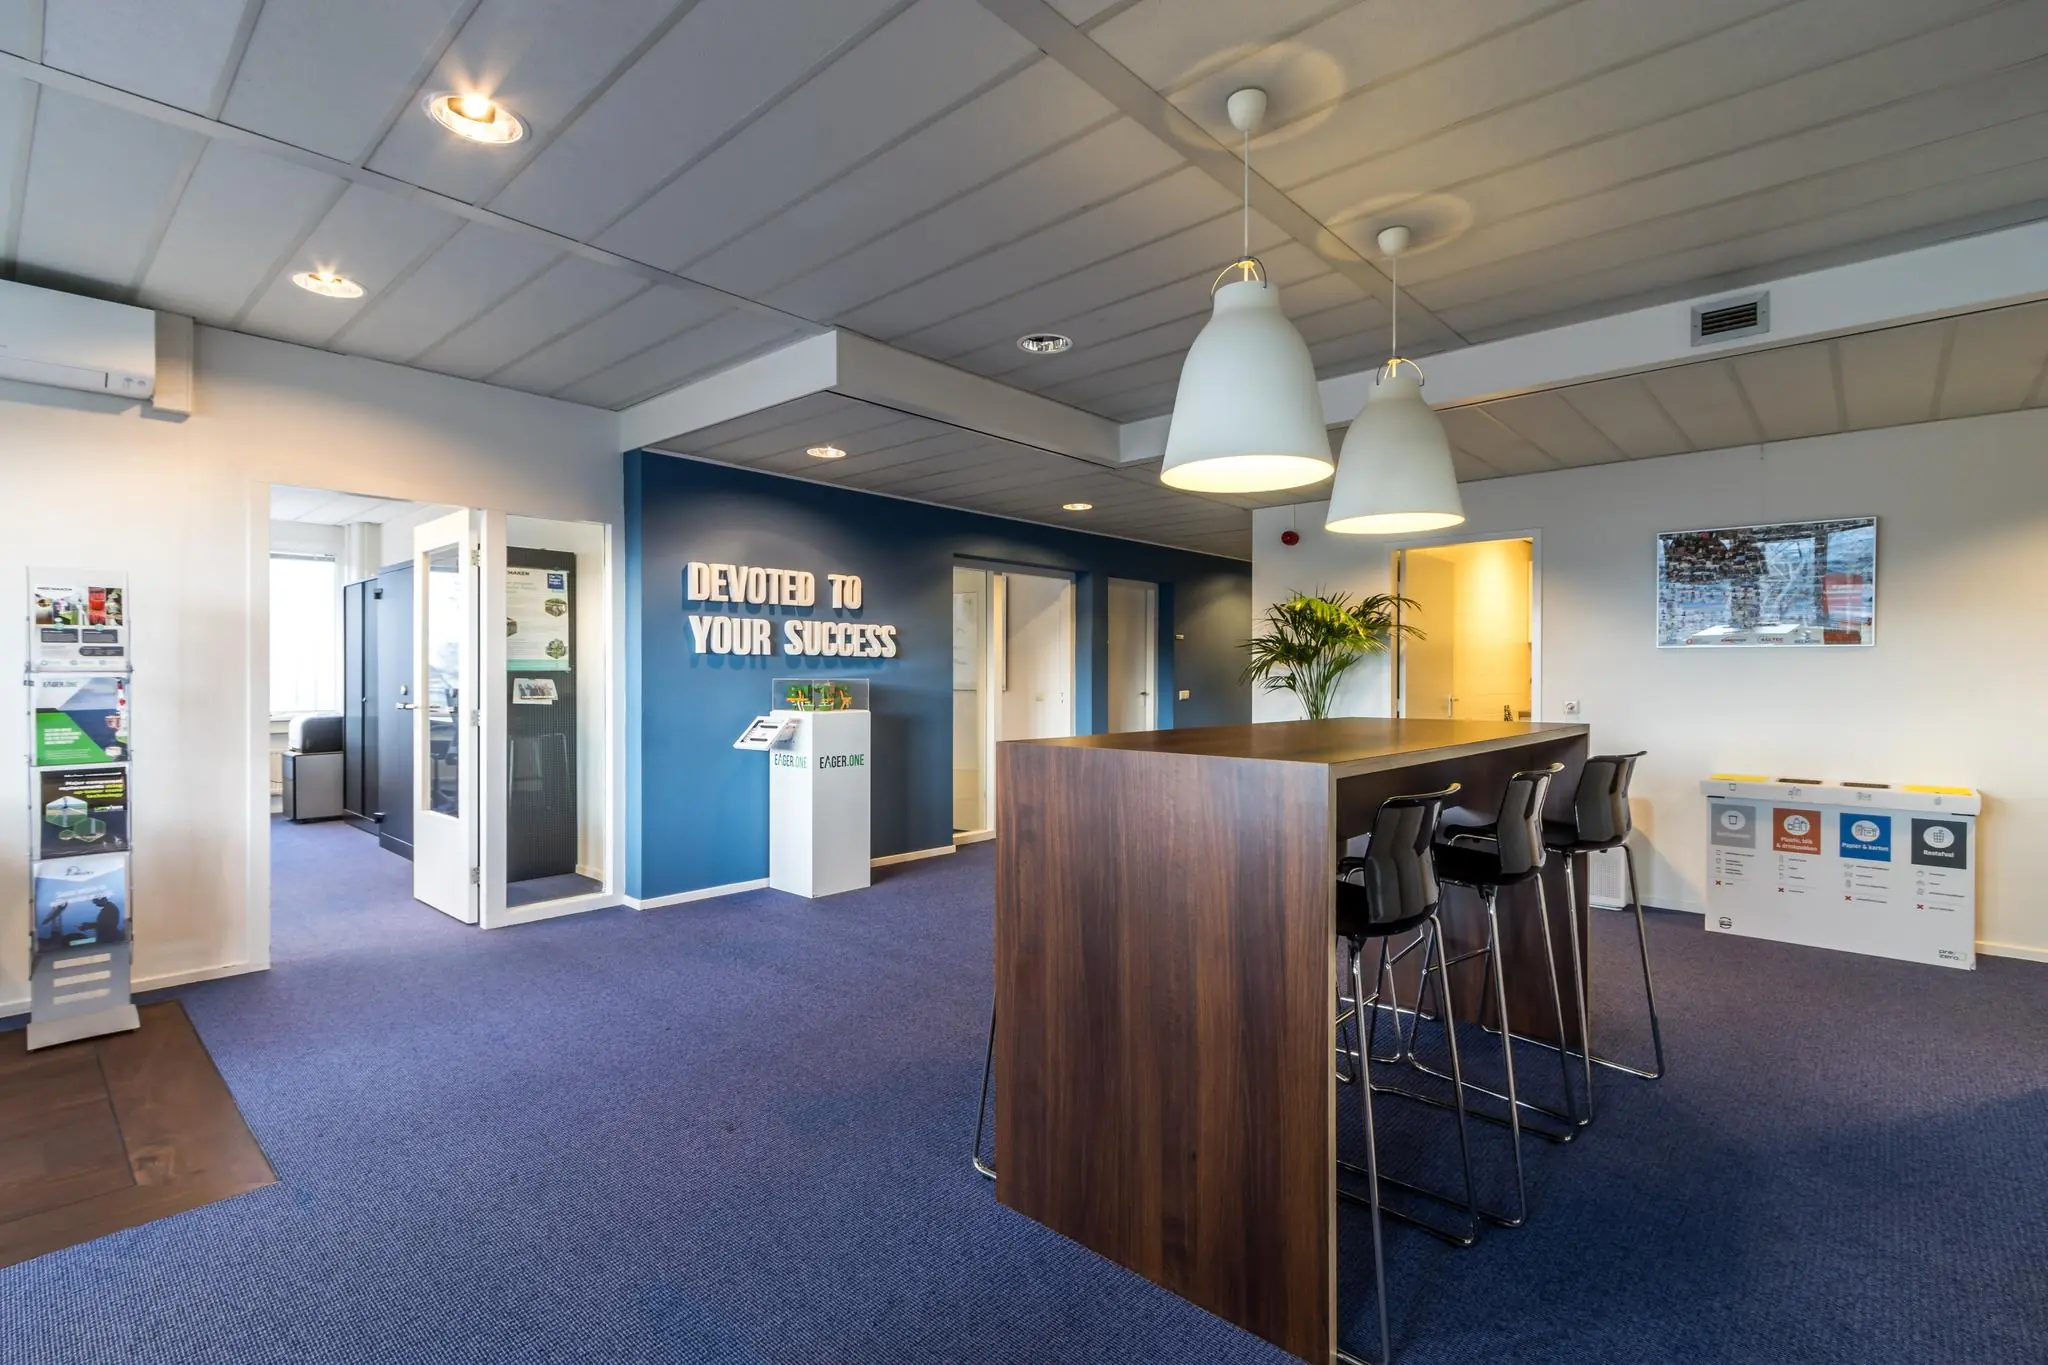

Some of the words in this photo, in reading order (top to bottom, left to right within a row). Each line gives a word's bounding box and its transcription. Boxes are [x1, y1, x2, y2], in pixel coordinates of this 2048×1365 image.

[686, 562, 816, 607] DEVOTED
[827, 574, 862, 610] TO
[688, 615, 771, 655] YOUR
[783, 619, 897, 658] SUCCESS
[774, 753, 807, 768] EAGER.ONE
[819, 753, 865, 769] EAGER.ONE
[1841, 842, 1861, 851] Papier
[1923, 849, 1955, 858] Restafval
